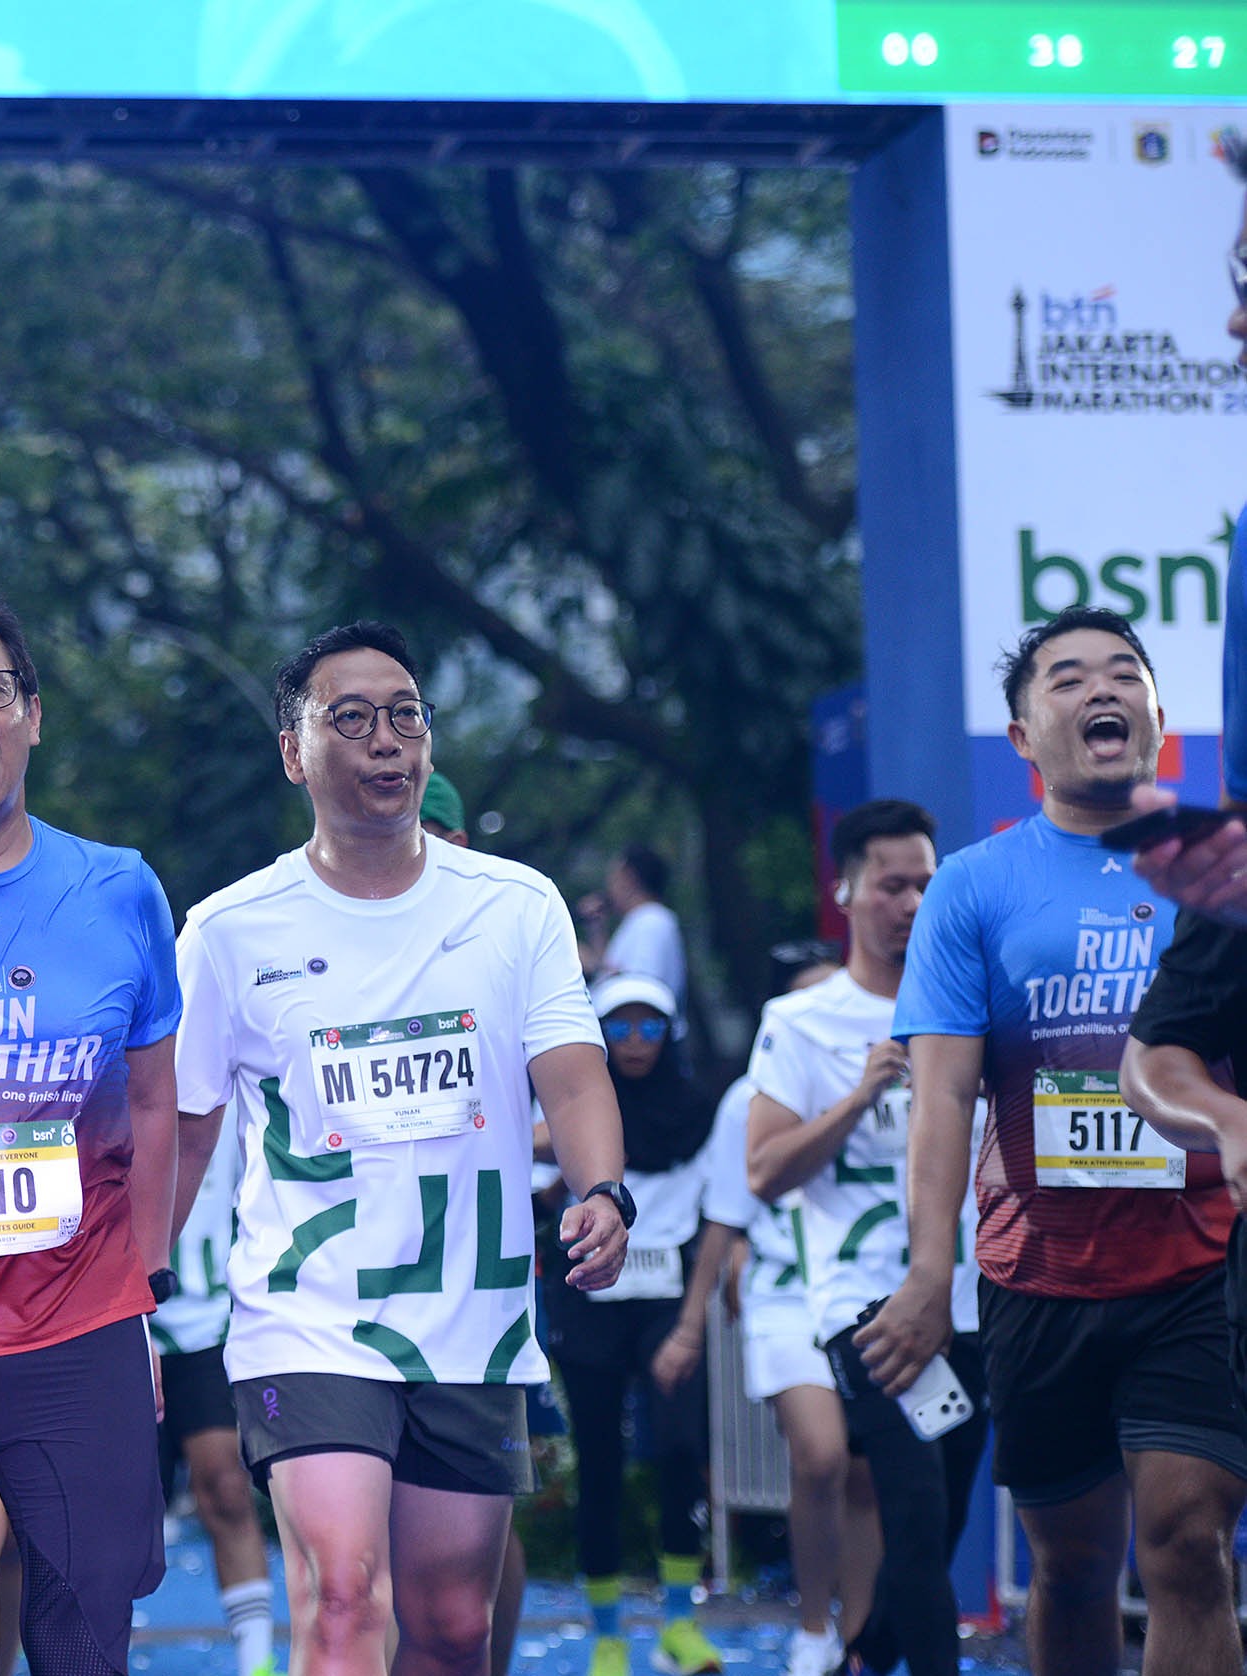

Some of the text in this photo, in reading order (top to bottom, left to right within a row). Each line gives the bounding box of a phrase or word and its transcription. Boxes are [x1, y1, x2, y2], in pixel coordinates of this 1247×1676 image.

[1172, 35, 1226, 69] 27
[1041, 293, 1118, 327] btn
[1038, 333, 1178, 354] JAKARTA
[1041, 391, 1213, 413] MARATHON
[1018, 528, 1218, 624] bsn
[1076, 925, 1154, 970] RUN
[438, 1018, 457, 1030] bsn
[322, 1047, 474, 1105] M 54724
[2, 1090, 26, 1101] one
[28, 1090, 60, 1104] finish
[62, 1090, 83, 1103] line
[33, 1129, 53, 1142] bsn
[1069, 1110, 1145, 1152] 5117
[0, 1151, 39, 1161] EVERYONE
[13, 1222, 35, 1231] GUIDE
